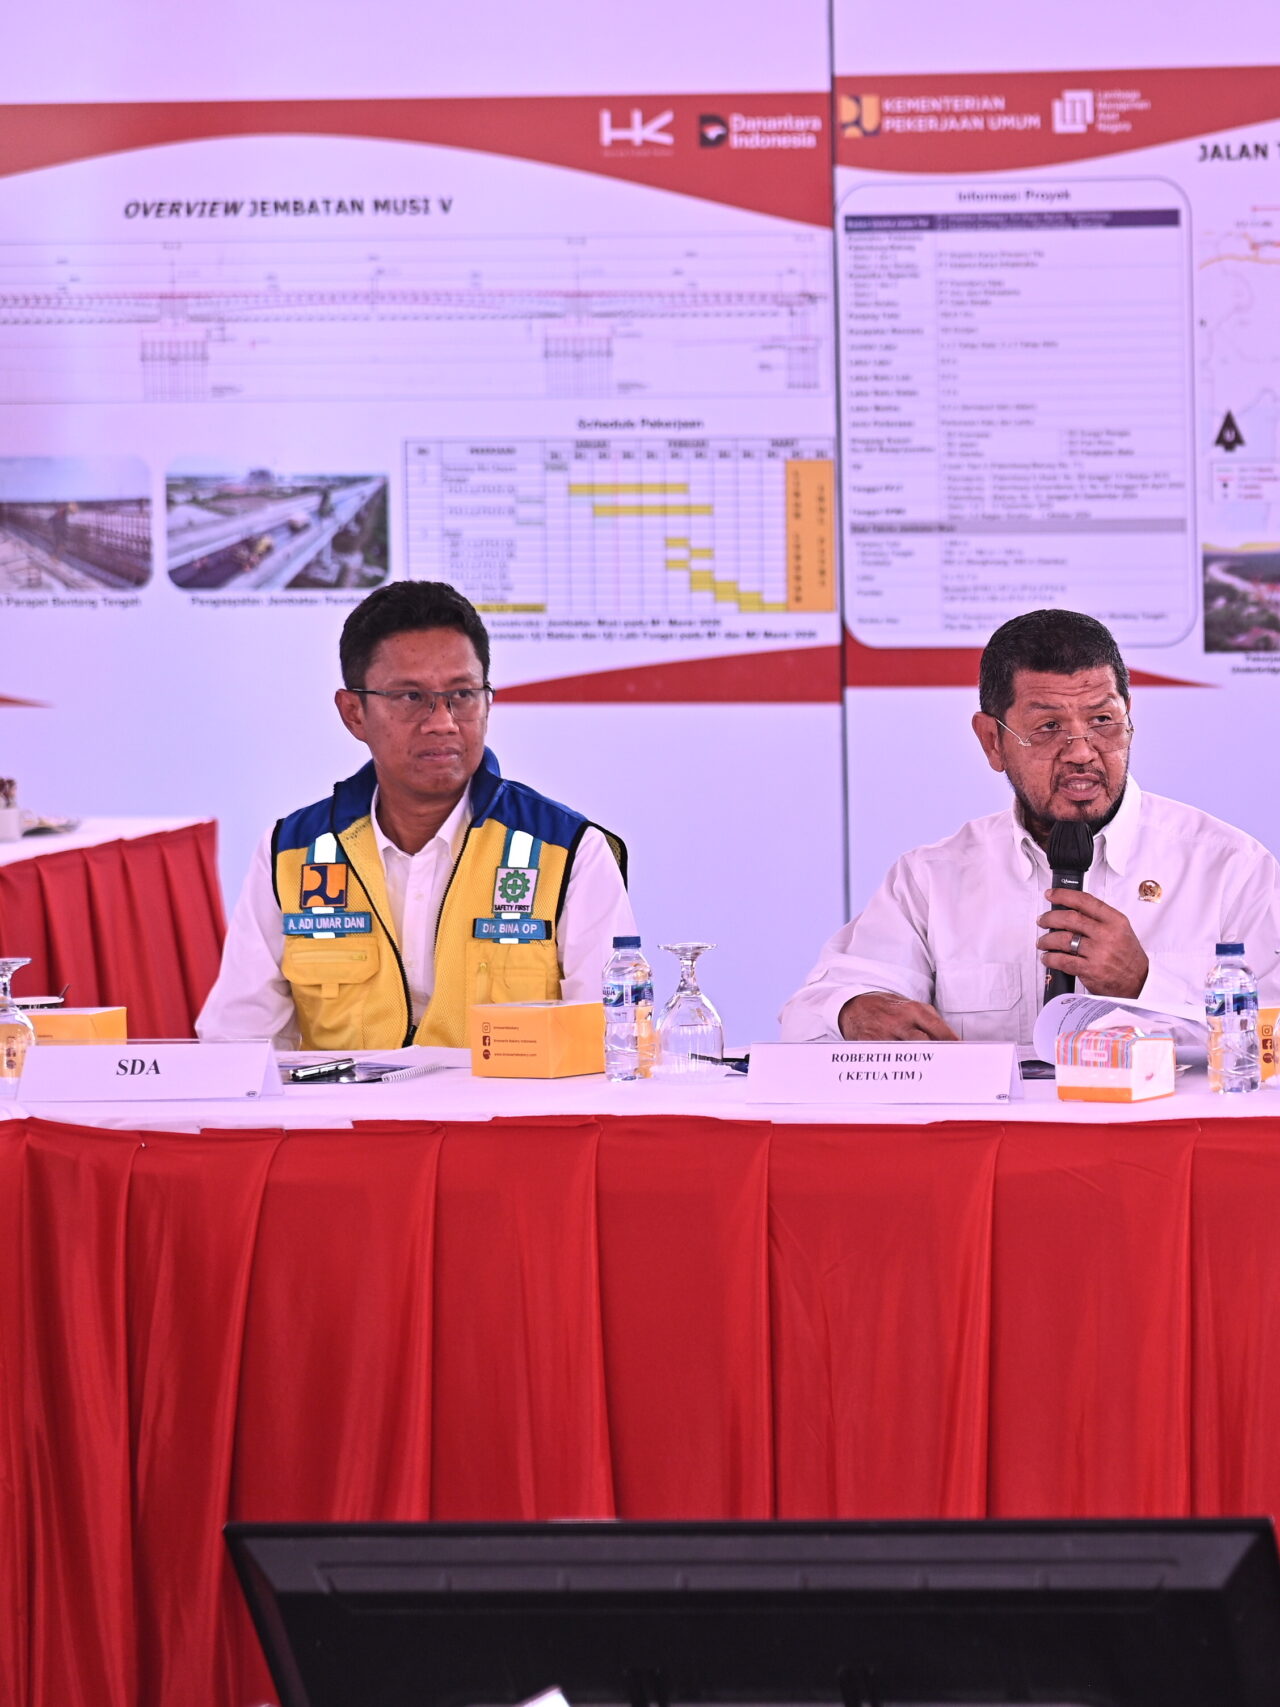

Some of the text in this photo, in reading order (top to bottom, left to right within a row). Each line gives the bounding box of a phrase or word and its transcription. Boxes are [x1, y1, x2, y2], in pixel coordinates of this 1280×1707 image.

[884, 96, 1005, 113] KEMENTERIAN
[601, 110, 674, 146] HK
[730, 112, 821, 132] Danantara
[884, 114, 1041, 133] PEKERJAAN UMUM
[730, 132, 817, 149] Indonesia
[1198, 143, 1269, 161] JALAN
[124, 198, 453, 219] OVERVIEW JEMBATAN MUSI V
[493, 904, 514, 912] SAFETY
[288, 916, 366, 930] A. ADI UMAR DANI
[482, 922, 539, 934] Dir. BINA OP
[831, 1052, 935, 1063] ROBERTH ROUW
[116, 1058, 161, 1077] SDA
[846, 1071, 889, 1082] KETUA
[891, 1070, 916, 1081] TIM
